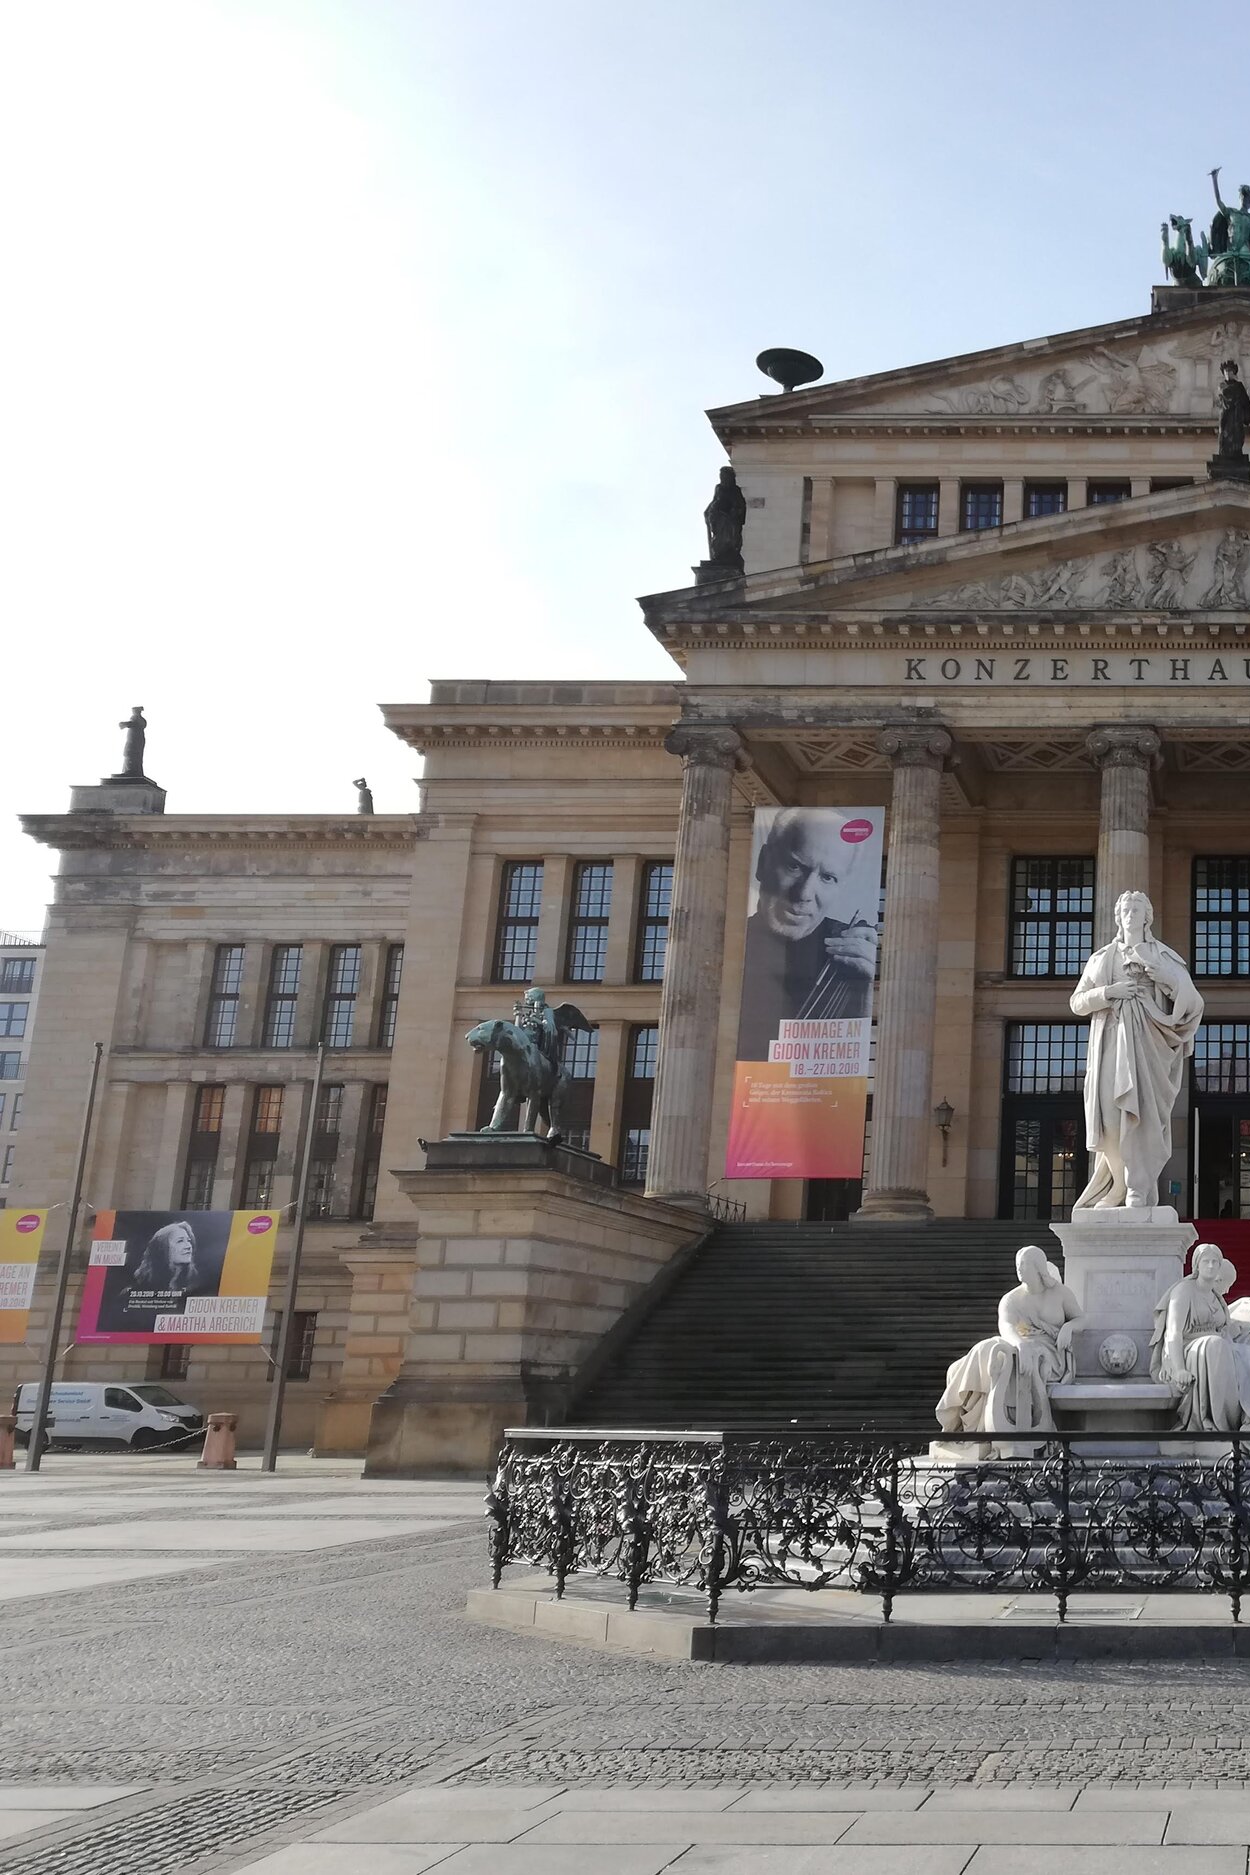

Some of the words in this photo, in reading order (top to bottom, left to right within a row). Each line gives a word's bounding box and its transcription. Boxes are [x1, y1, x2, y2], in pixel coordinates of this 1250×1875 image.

[783, 1021, 844, 1039] HOMMAGE
[846, 1020, 862, 1038] AN
[773, 1042, 810, 1060] GIDON
[813, 1041, 861, 1060] KREMER
[18, 1265, 31, 1279] AN
[188, 1298, 218, 1314] GIDON
[219, 1298, 259, 1314] KREMER
[157, 1316, 167, 1332] &
[166, 1316, 207, 1332] MARTHA
[208, 1316, 257, 1332] ARGERICH
